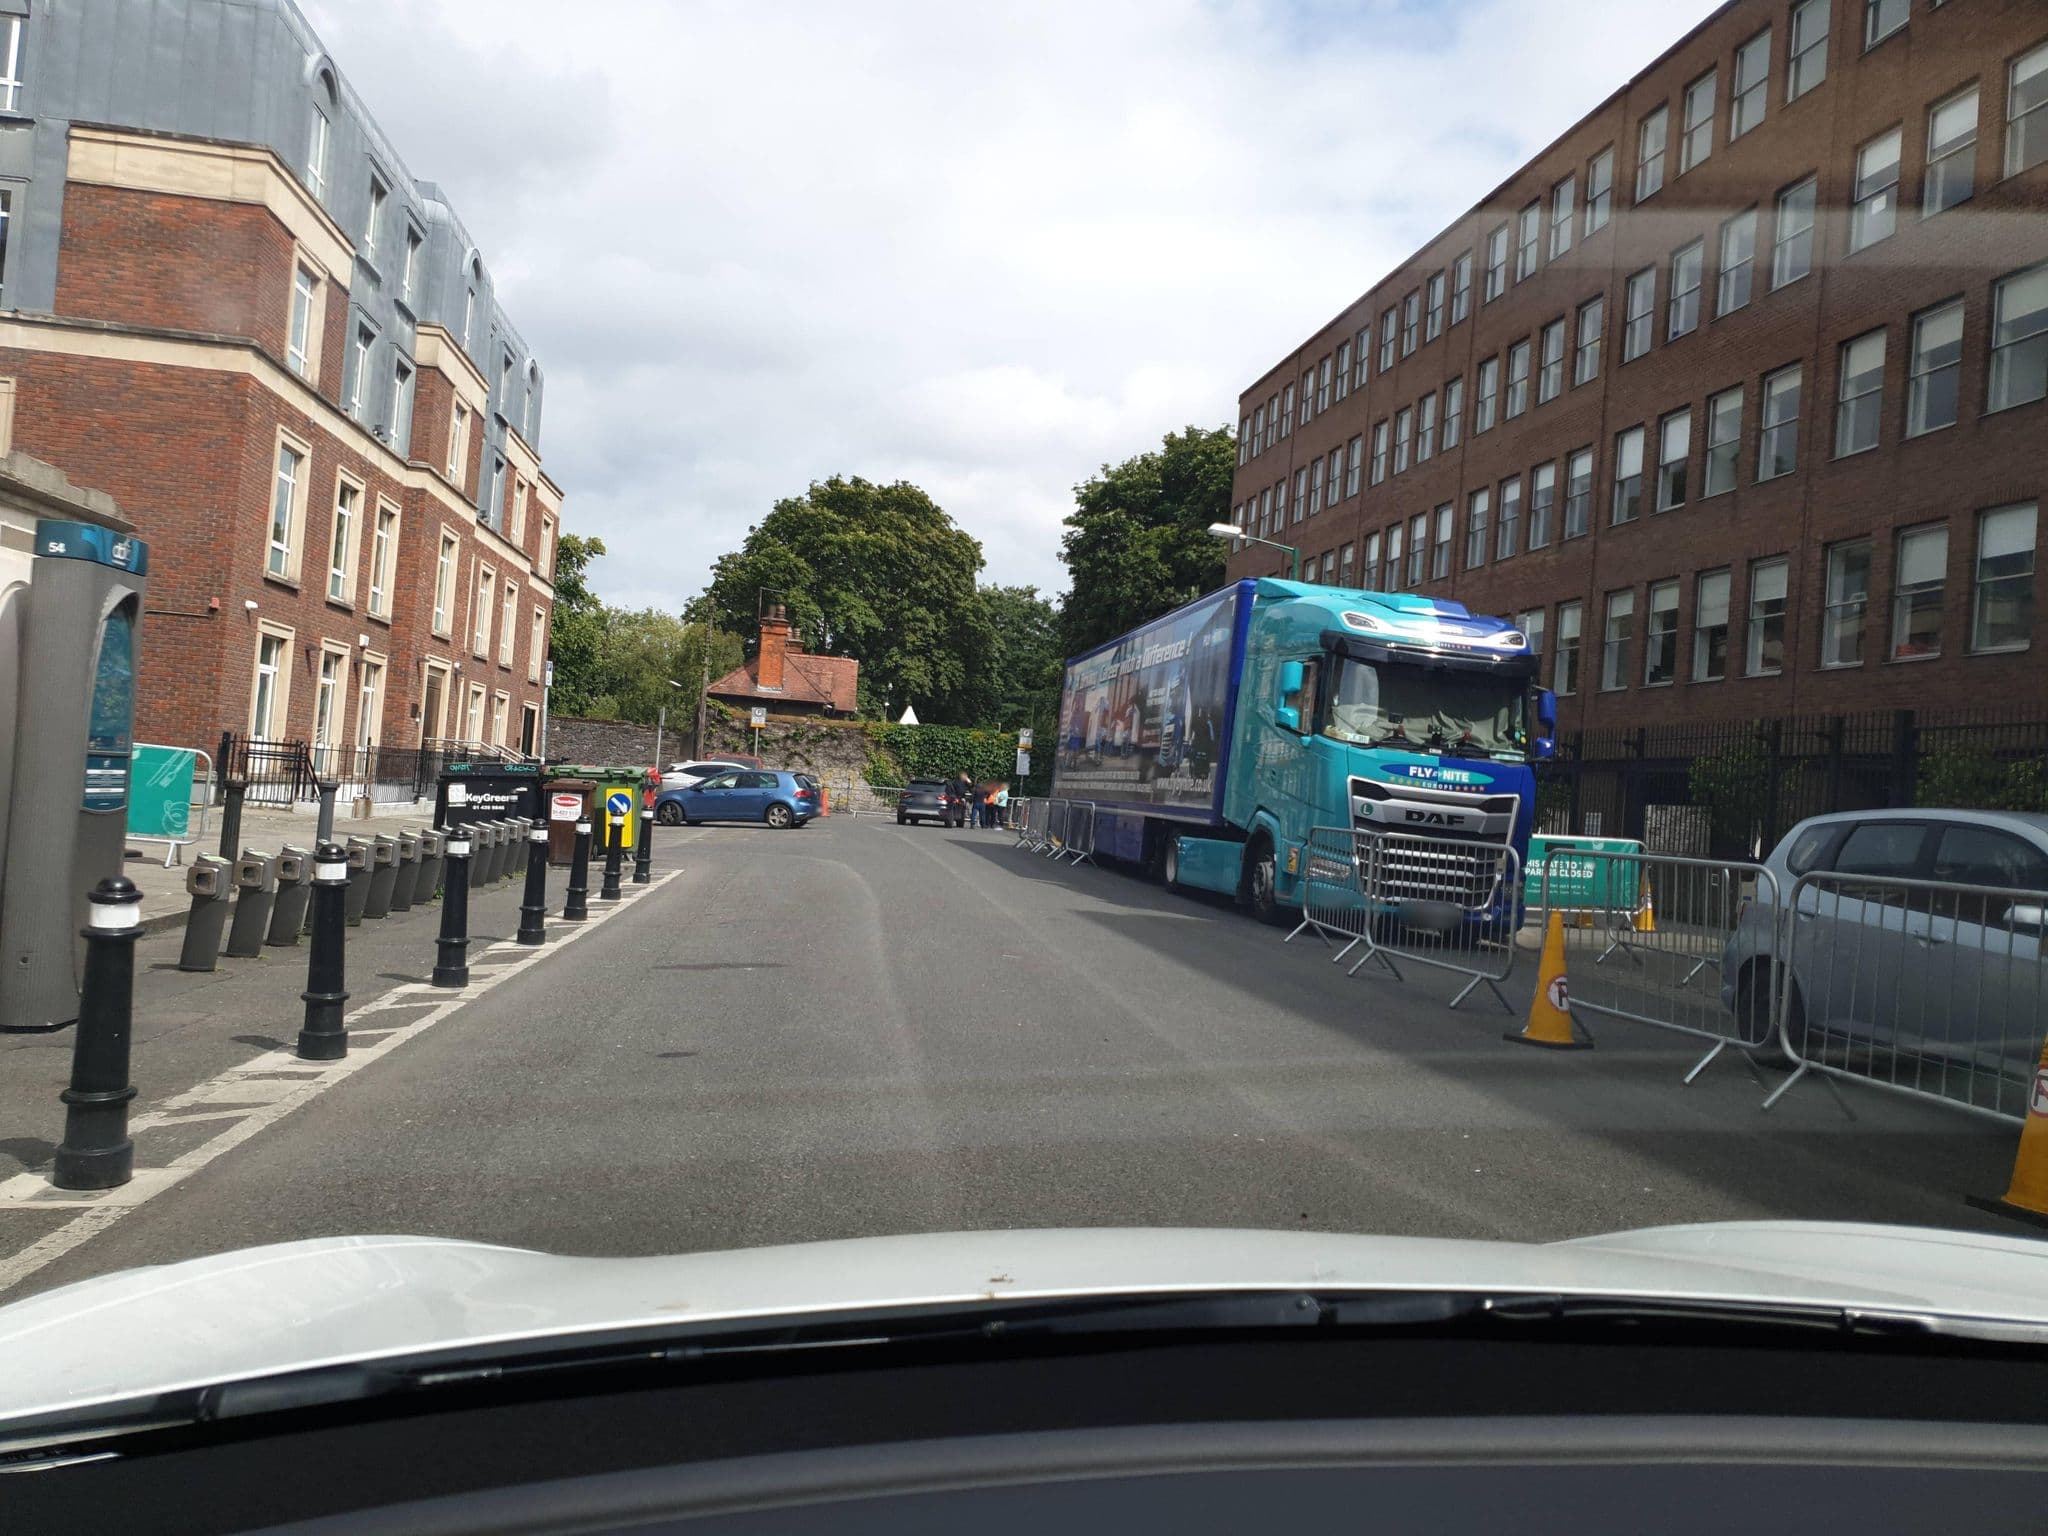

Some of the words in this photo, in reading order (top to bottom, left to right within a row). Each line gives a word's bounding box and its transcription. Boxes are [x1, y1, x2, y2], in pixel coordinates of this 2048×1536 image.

[49, 542, 66, 553] 54
[1120, 656, 1136, 675] with
[1142, 640, 1186, 669] Difference
[1409, 766, 1434, 778] FLY
[1443, 770, 1470, 783] NITE
[1422, 782, 1453, 790] EUROPE
[1405, 809, 1465, 826] DAF
[1526, 859, 1540, 868] HIS
[1525, 867, 1544, 876] PAR
[1560, 869, 1594, 879] CLOSED
